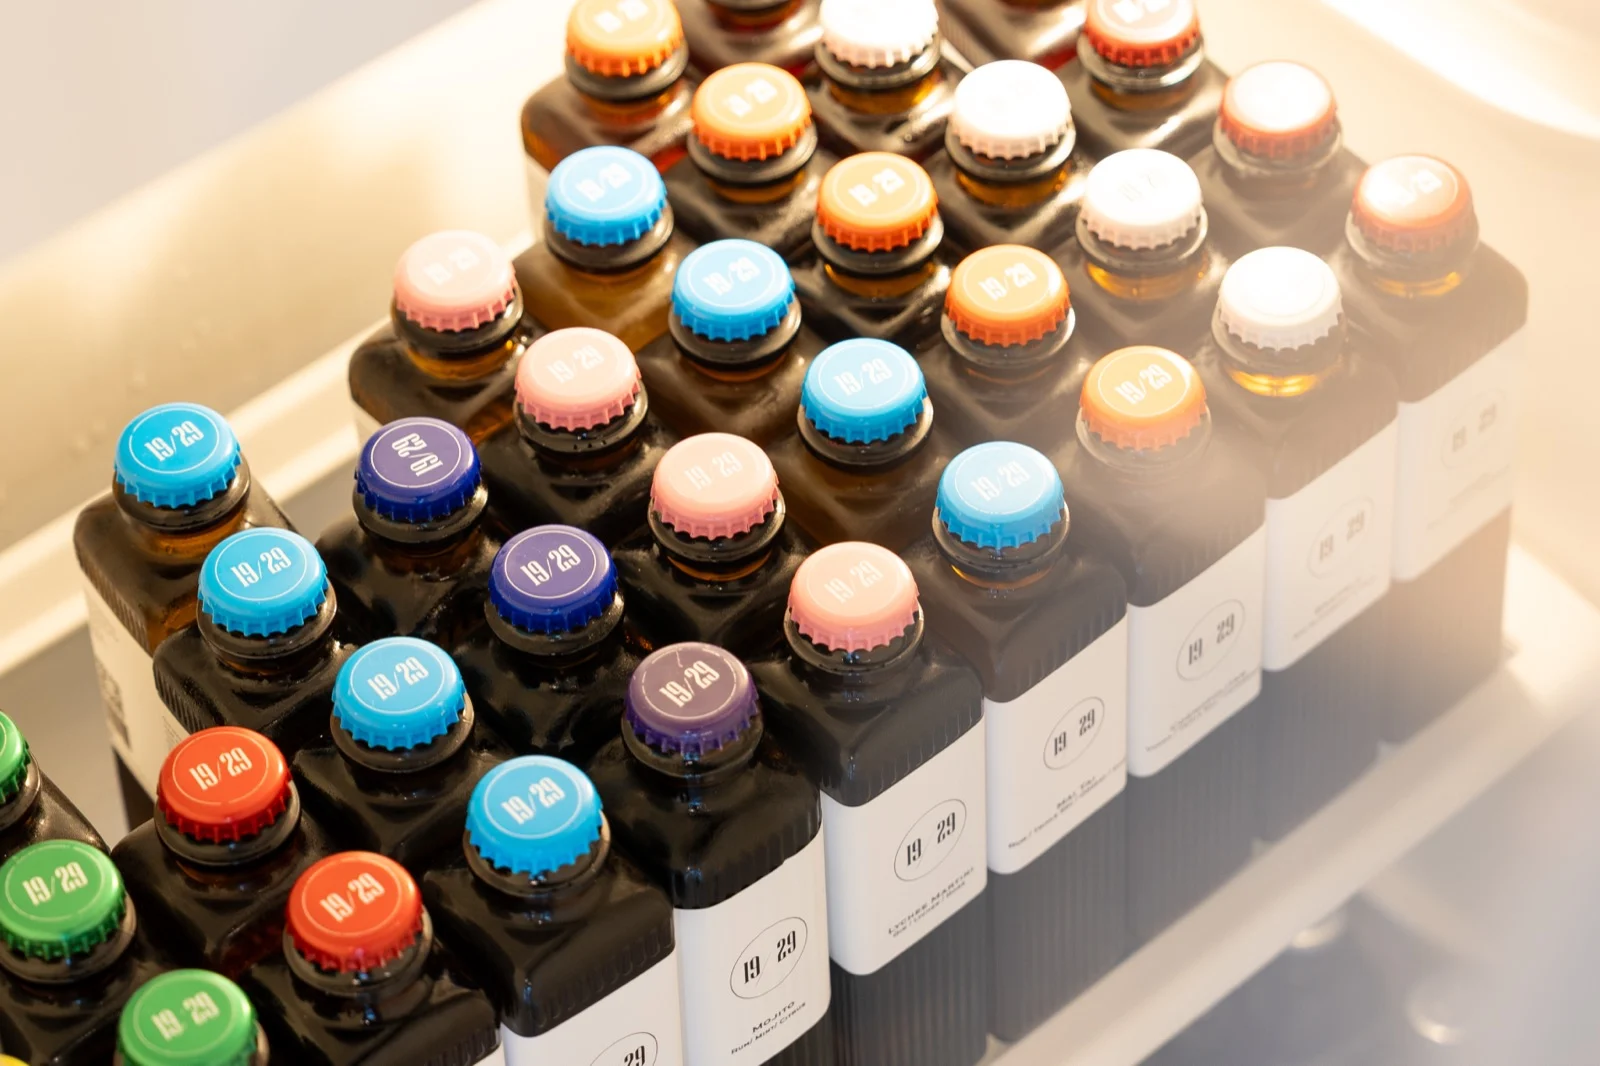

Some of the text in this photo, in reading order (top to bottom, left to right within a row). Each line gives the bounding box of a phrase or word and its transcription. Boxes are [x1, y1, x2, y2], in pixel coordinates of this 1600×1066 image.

[144, 420, 204, 463] 19/29
[392, 432, 444, 477] 19/29
[230, 546, 293, 589] 19/29
[519, 544, 582, 587] 19/29
[367, 656, 431, 701] 19/29
[658, 660, 720, 709] 19/29
[188, 747, 253, 791] 19/29
[501, 776, 566, 825] 19/29
[22, 861, 89, 907] 19/29
[319, 872, 386, 923] 19/29
[752, 1001, 795, 1033] MOJITO
